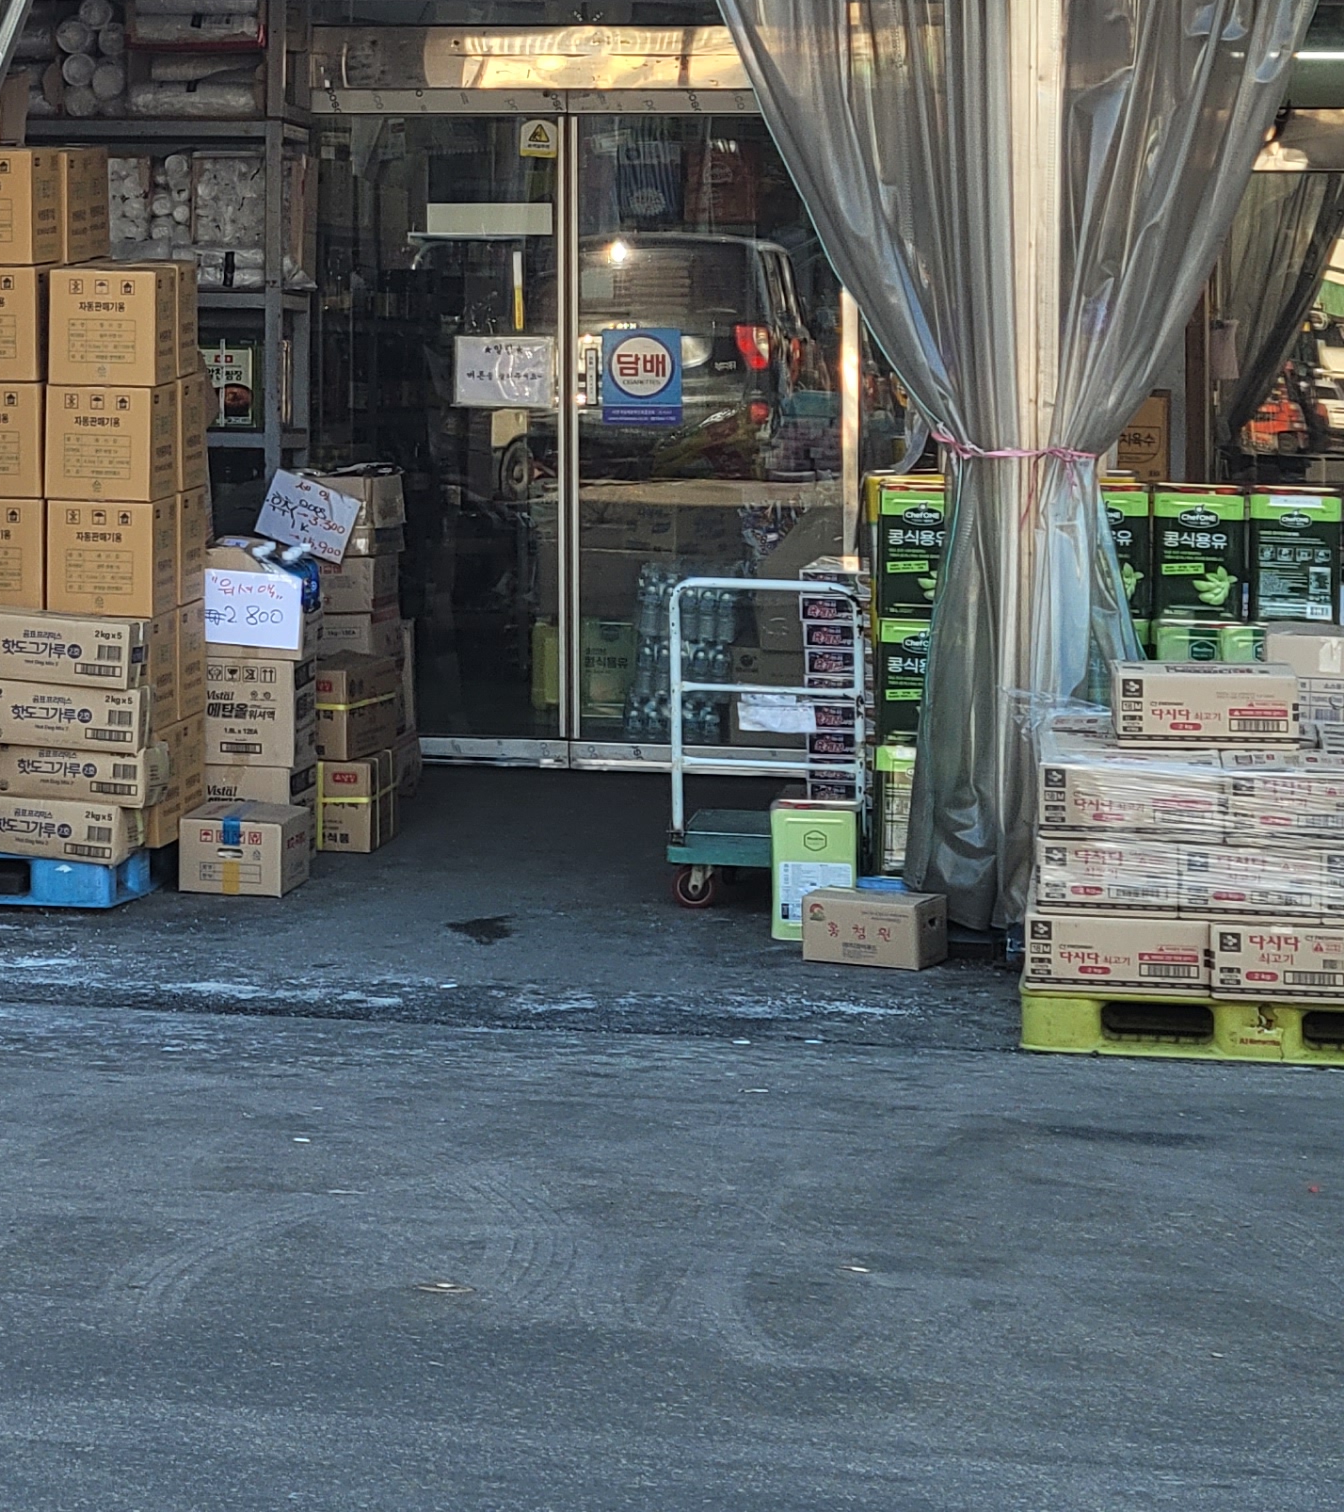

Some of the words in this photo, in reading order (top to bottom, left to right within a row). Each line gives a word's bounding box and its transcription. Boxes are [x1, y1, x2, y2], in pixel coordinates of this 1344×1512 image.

[78, 301, 126, 313] 자동판매기용
[616, 353, 666, 378] 담배
[74, 414, 121, 428] 자동판매기용
[75, 530, 123, 543] 자동판매기용
[1163, 531, 1228, 550] 콩식용유
[1, 638, 67, 660] 핫도그가루
[10, 704, 77, 724] 핫도그가루
[207, 702, 248, 719] 에탄올
[248, 709, 276, 721] 워셔액
[1151, 708, 1191, 721] 다시다
[1193, 711, 1222, 721] 쇠고기
[17, 757, 82, 778] 핫도그가루
[1249, 934, 1301, 951] 다시다
[1059, 950, 1099, 964] 다시다
[1102, 954, 1131, 966] 쇠고기
[1258, 952, 1294, 965] 쇠고기
